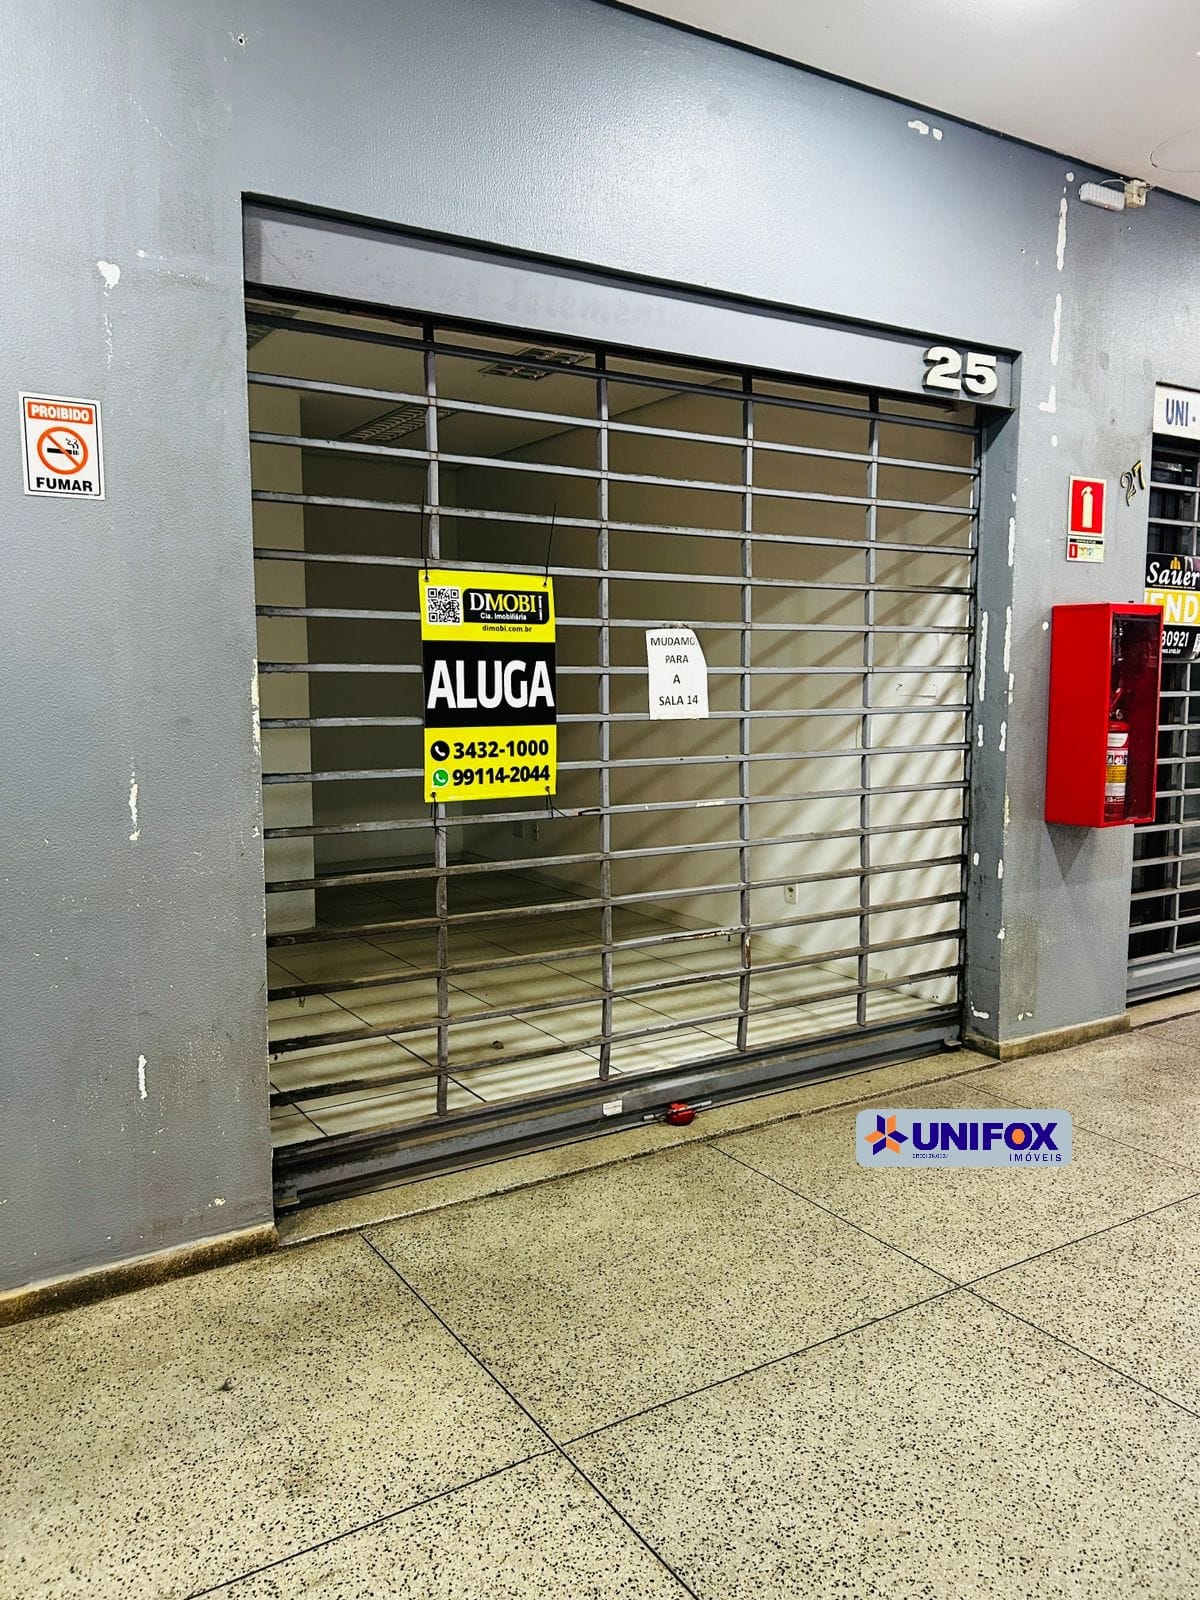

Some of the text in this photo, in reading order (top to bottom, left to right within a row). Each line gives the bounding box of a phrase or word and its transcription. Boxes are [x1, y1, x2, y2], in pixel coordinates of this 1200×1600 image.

[923, 345, 998, 396] 25
[31, 404, 90, 422] PROIBIDO
[1165, 397, 1189, 427] UNI
[36, 477, 93, 492] FUMAR
[1120, 460, 1145, 507] 27
[1146, 561, 1200, 588] Sauer
[480, 612, 527, 621] Cia. Imobiliária
[482, 625, 532, 633] dimobi.com.br
[650, 637, 697, 646] MUDAMO
[665, 655, 689, 664] PARA
[427, 660, 555, 709] ALUGA
[673, 674, 681, 684] A
[659, 695, 698, 706] SALA 14
[453, 740, 549, 759] 3432-1000
[452, 765, 550, 786] 99114-2044
